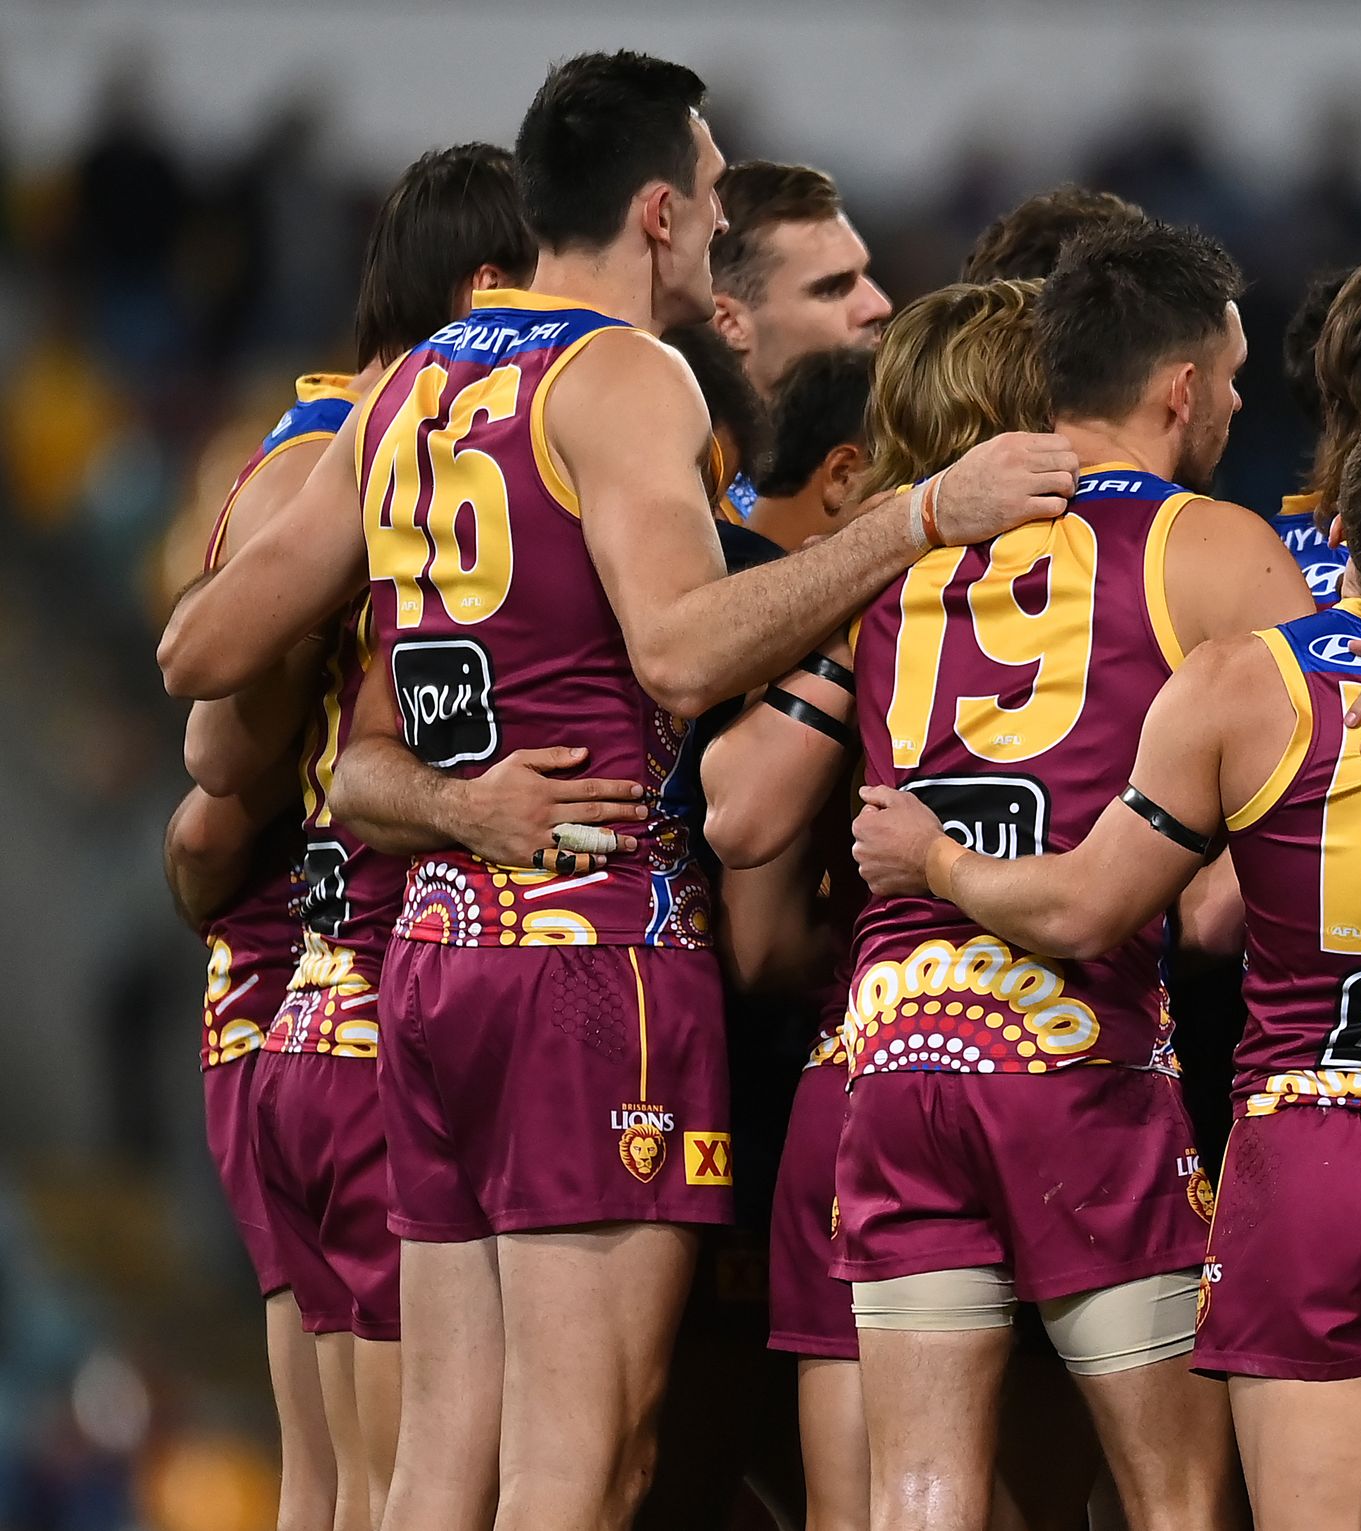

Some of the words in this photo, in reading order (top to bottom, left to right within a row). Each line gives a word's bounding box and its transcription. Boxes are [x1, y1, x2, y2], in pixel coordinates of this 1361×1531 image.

[362, 361, 522, 629] 46
[460, 597, 481, 608] AFL
[886, 512, 1098, 770] 19
[402, 663, 473, 746] youi
[993, 735, 1021, 745] AFL
[942, 802, 1018, 860] oui
[1332, 927, 1361, 937] AFL
[622, 1103, 664, 1112] BRISBANE
[610, 1110, 675, 1132] LIONS
